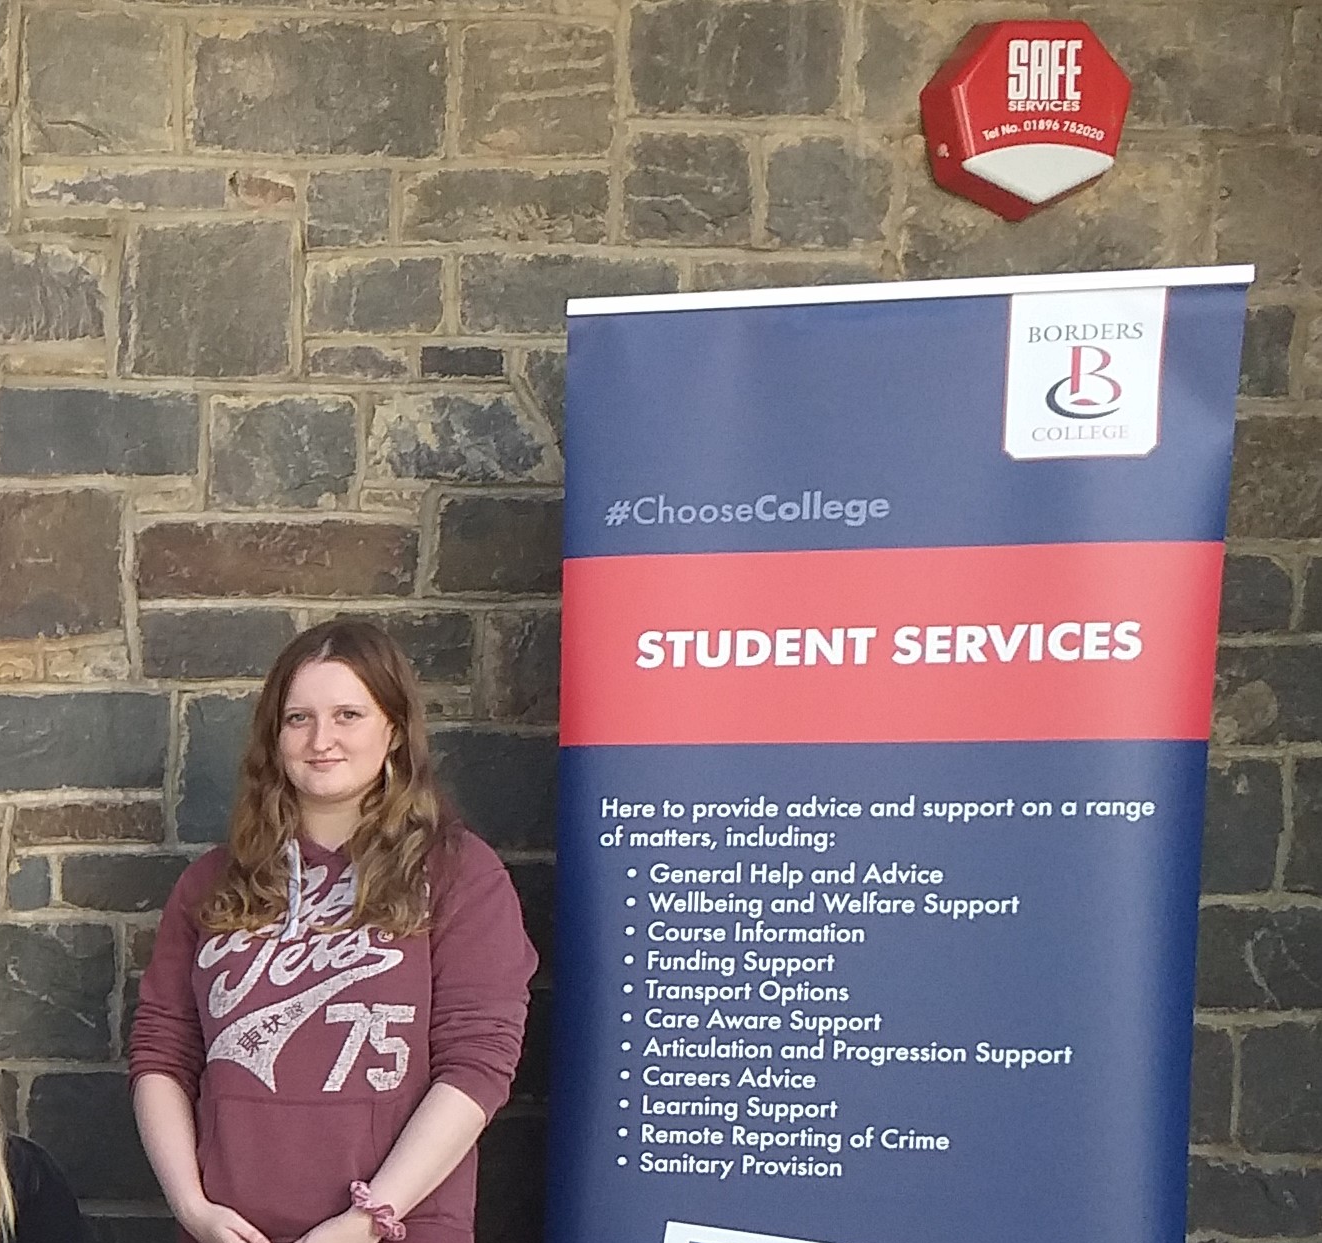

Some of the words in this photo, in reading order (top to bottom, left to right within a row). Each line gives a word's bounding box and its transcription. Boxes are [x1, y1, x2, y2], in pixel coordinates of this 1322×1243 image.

[1008, 40, 1082, 100] SAFE
[1008, 101, 1079, 111] SERVICES
[982, 128, 1001, 141] Tel
[1023, 120, 1059, 131] 01896
[1028, 322, 1143, 344] BORDERS
[1031, 424, 1129, 442] COLLEGE
[605, 491, 890, 526] #ChooseCollege
[636, 628, 877, 668] STUDENT
[892, 621, 1142, 664] SERVICES
[602, 798, 655, 818] Here
[663, 800, 685, 818] to
[693, 796, 778, 823] provide
[787, 796, 862, 817] advice
[870, 795, 915, 817] and
[923, 799, 1014, 822] support
[1022, 802, 1052, 816] on
[1061, 802, 1077, 815] a
[1086, 802, 1155, 821] range
[600, 825, 623, 846] of
[630, 829, 717, 850] matters,
[727, 825, 835, 852] including:
[650, 862, 741, 883] General
[751, 862, 803, 889] Help
[811, 862, 855, 883] and
[863, 862, 943, 884] Advice
[649, 891, 762, 918] Wellbeing
[771, 892, 814, 913] and
[822, 892, 915, 913] Welfare
[924, 893, 1019, 919] Support
[648, 922, 726, 941] Course
[735, 921, 864, 942] Information
[648, 949, 735, 976] Funding
[744, 951, 835, 977] Support
[645, 980, 752, 1005] Transport
[759, 981, 849, 1006] Options
[645, 1009, 699, 1028] Care
[706, 1009, 781, 1029] Aware
[790, 1010, 882, 1036] Support
[322, 1002, 415, 1092] 75
[643, 1037, 772, 1058] Articulation
[781, 1038, 824, 1059] and
[833, 1040, 966, 1066] Progression
[976, 1042, 1072, 1069] Support
[643, 1066, 730, 1087] Careers
[737, 1067, 816, 1088] Advice
[643, 1095, 738, 1121] Learning
[747, 1097, 838, 1123] Support
[642, 1124, 723, 1144] Remote
[732, 1126, 841, 1153] Reporting
[850, 1127, 874, 1148] of
[881, 1129, 949, 1150] Crime
[640, 1153, 734, 1179] Sanitary
[742, 1155, 842, 1176] Provision
